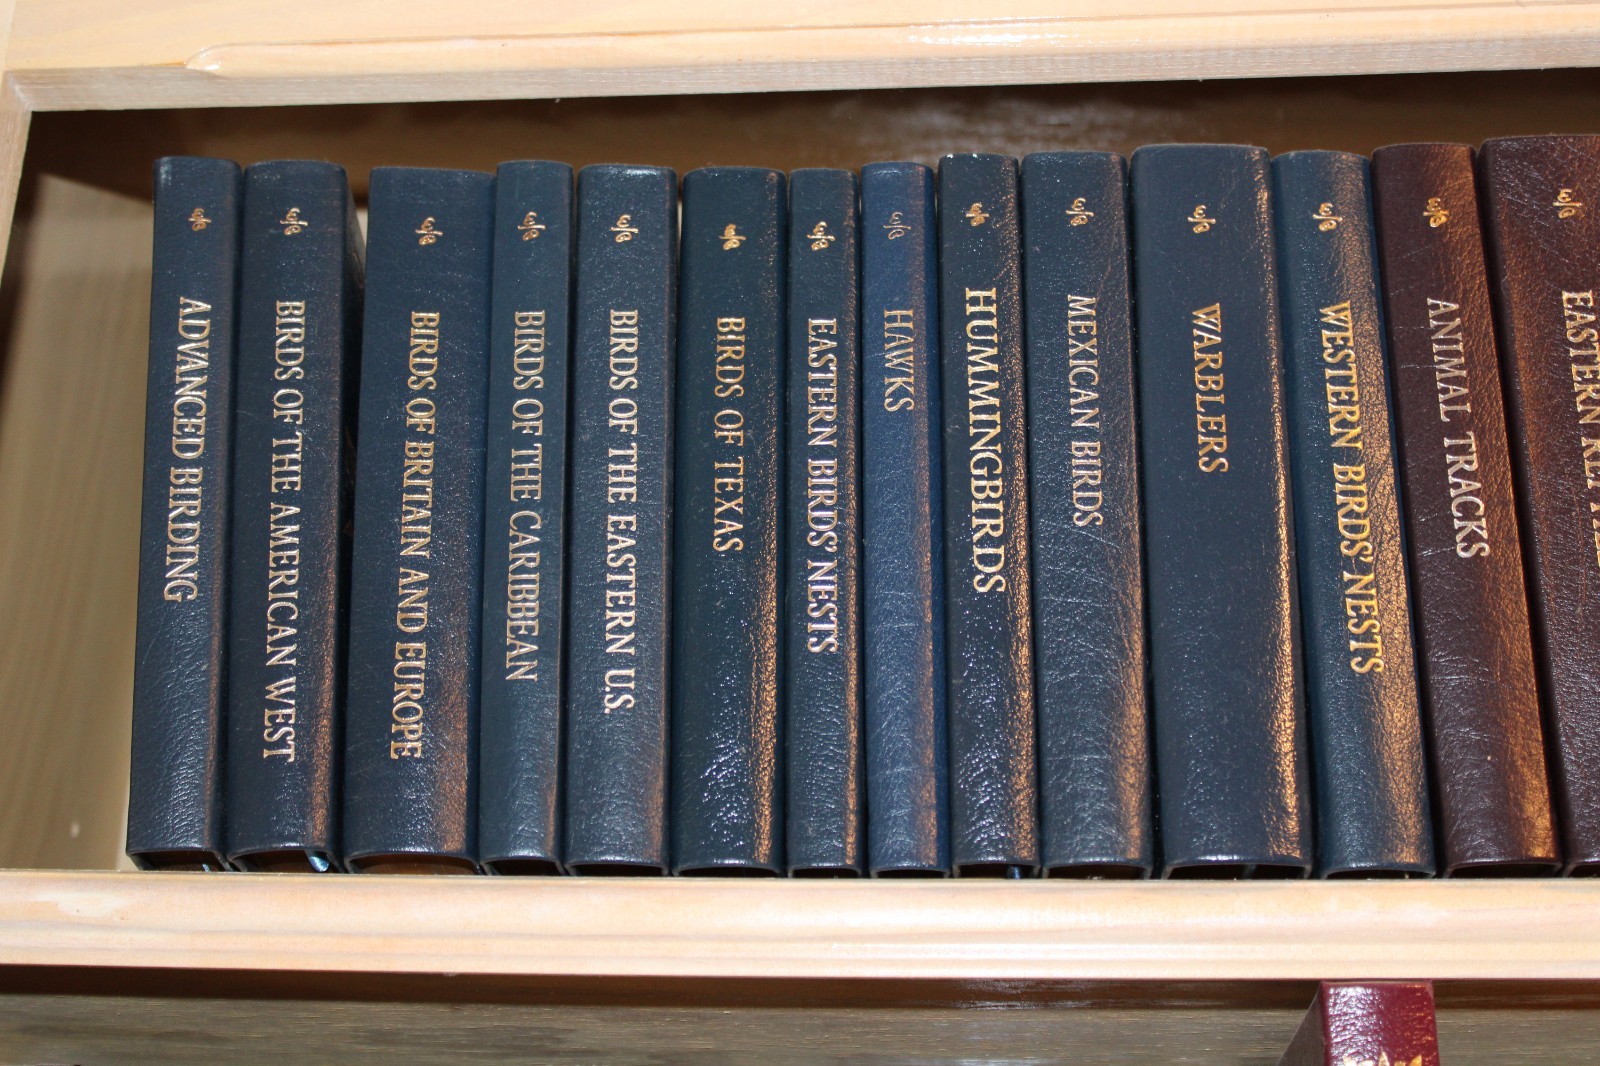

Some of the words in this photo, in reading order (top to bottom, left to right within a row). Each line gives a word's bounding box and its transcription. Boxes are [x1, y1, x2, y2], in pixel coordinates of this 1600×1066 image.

[171, 297, 211, 459] ADVANCED
[274, 300, 305, 381] BIRDS
[407, 312, 440, 391] BIRDS
[513, 311, 545, 390] BIRDS
[609, 309, 638, 390] BIRDS
[715, 317, 745, 398] BIRDS
[808, 318, 837, 446] EASTERN
[883, 309, 914, 412] HAWKS
[1067, 295, 1101, 429] MEXICAN
[1427, 298, 1471, 422] ANIMAL
[272, 389, 304, 426] OF
[405, 398, 435, 434] OF
[512, 398, 543, 435] OF
[608, 398, 637, 434] OF
[714, 410, 744, 446] OF
[1192, 303, 1228, 473] WARBLERS
[271, 432, 302, 492] THE
[510, 444, 543, 501] THE
[608, 444, 637, 502] THE
[965, 288, 1007, 593] HUMMINGBIRDS
[1071, 442, 1103, 527] BIRDS
[400, 442, 434, 559] BRITAIN
[713, 459, 743, 552] TEXAS
[1319, 301, 1363, 449] WESTERN
[1343, 571, 1384, 673] NESTS
[1444, 432, 1490, 559] TRACKS
[164, 467, 203, 602] BIRDING
[266, 502, 302, 667] AMERICAN
[398, 567, 428, 633] AND
[506, 511, 540, 682] CARIBBEAN
[606, 515, 637, 656] EASTERN
[807, 560, 838, 653] NESTS
[263, 677, 296, 762] WEST
[390, 642, 426, 759] EUROPE
[604, 668, 635, 714] U.S.
